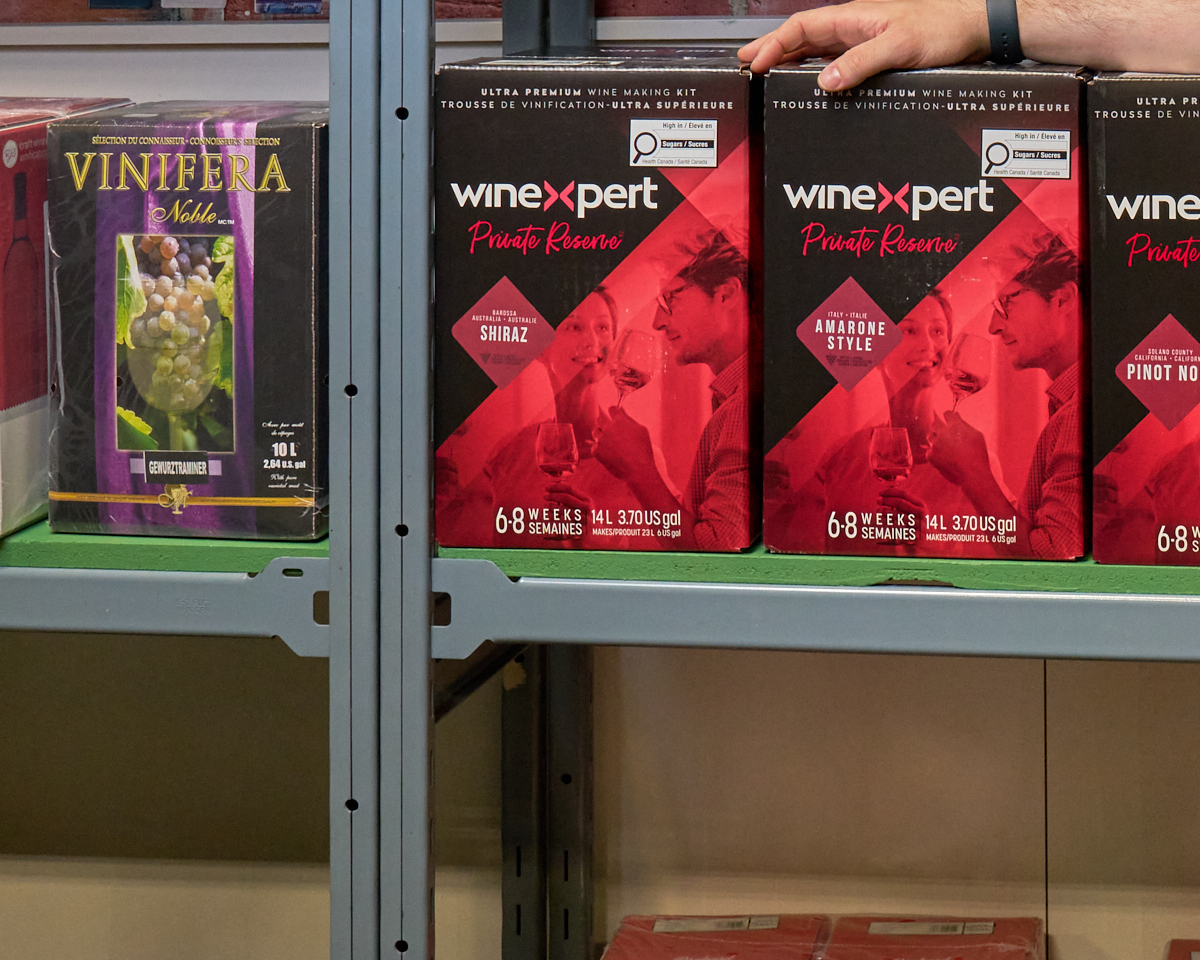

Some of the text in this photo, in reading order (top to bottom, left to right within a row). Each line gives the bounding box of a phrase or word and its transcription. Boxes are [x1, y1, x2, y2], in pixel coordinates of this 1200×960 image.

[481, 88, 697, 97] ULTRA PREMIUM WINE MAKING KIT
[441, 100, 495, 109] TROUSSE
[501, 101, 516, 109] DE
[656, 99, 734, 110] SUPÉRIEURE
[64, 152, 292, 192] VINIFERA
[151, 199, 218, 224] Noble
[468, 220, 623, 255] Private Reserve
[800, 222, 958, 258] Private Reserve
[480, 325, 528, 343] SHIRAZ
[815, 319, 886, 336] AMARONE
[827, 336, 873, 352] STYLE
[1127, 363, 1172, 381] PINOT
[272, 442, 297, 457] 10 L
[149, 460, 207, 475] GEWURZTRAMINER
[528, 508, 582, 521] WEEKS
[861, 513, 916, 526] WEEKS
[528, 521, 583, 535] SEMAINES
[861, 527, 916, 540] SEMAINES
